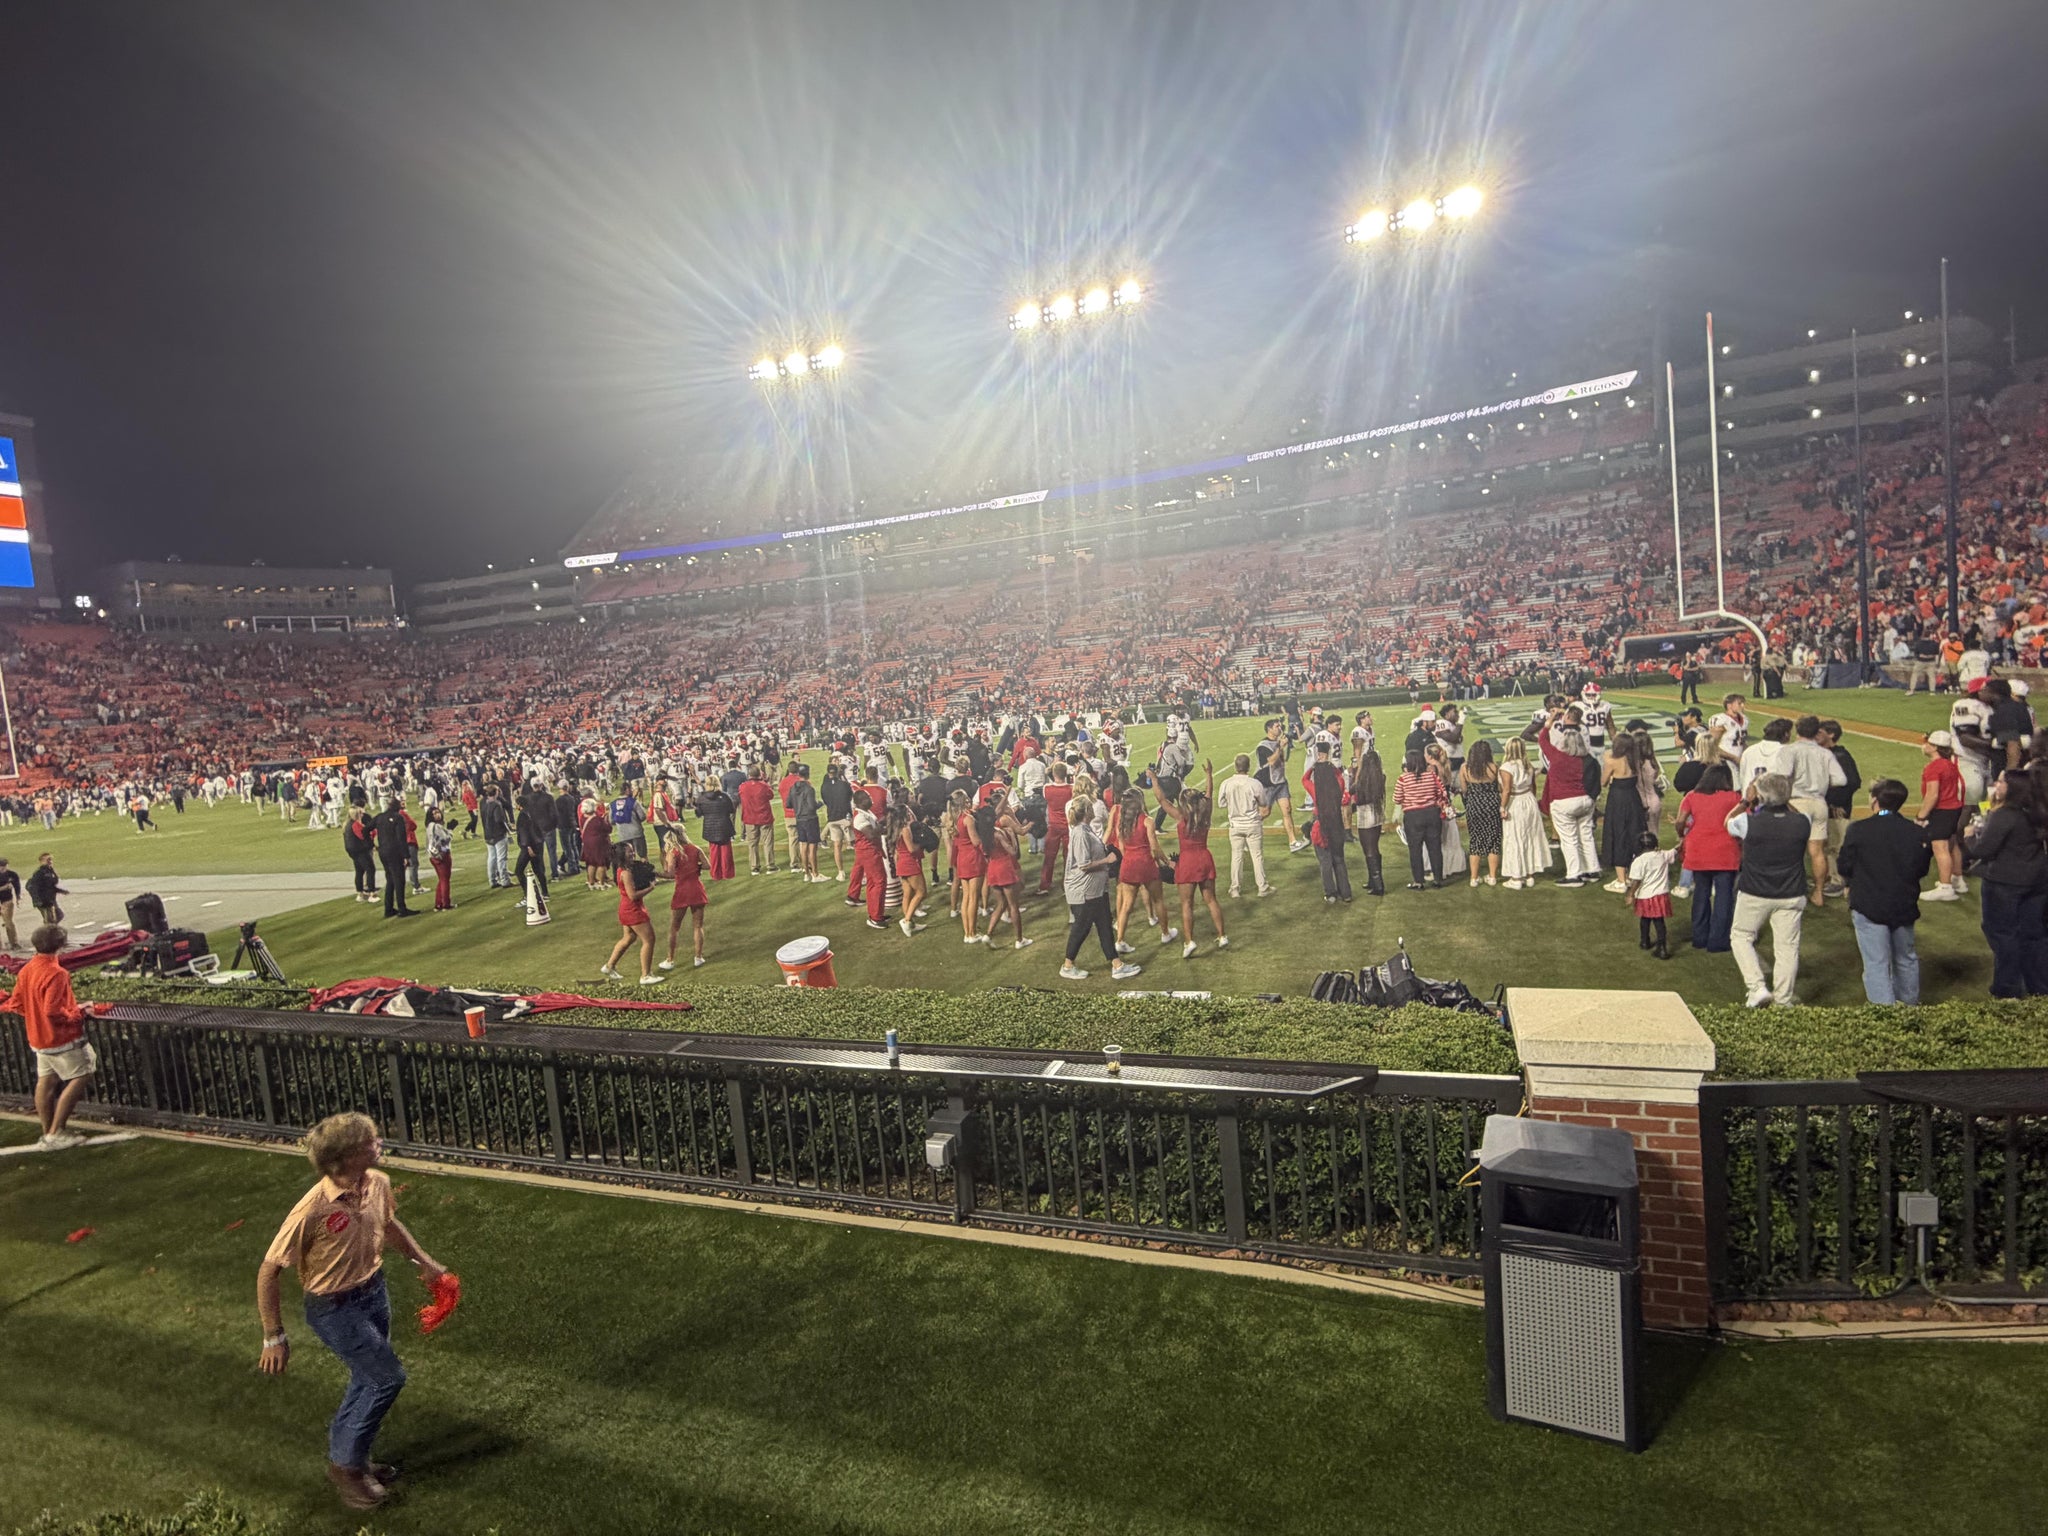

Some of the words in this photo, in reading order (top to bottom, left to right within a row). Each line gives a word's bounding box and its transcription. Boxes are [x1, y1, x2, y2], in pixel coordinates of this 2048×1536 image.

[1246, 449, 1275, 462] LISTEN
[1286, 443, 1304, 455] THE
[1303, 436, 1343, 451] REGIONS
[1369, 420, 1420, 439] POSTGAME
[1420, 414, 1450, 429] SHOW
[1450, 410, 1466, 422] ON
[1499, 399, 1521, 411] FOR
[782, 530, 804, 539] LISTEN
[1585, 711, 1607, 727] 96
[872, 746, 886, 757] 52
